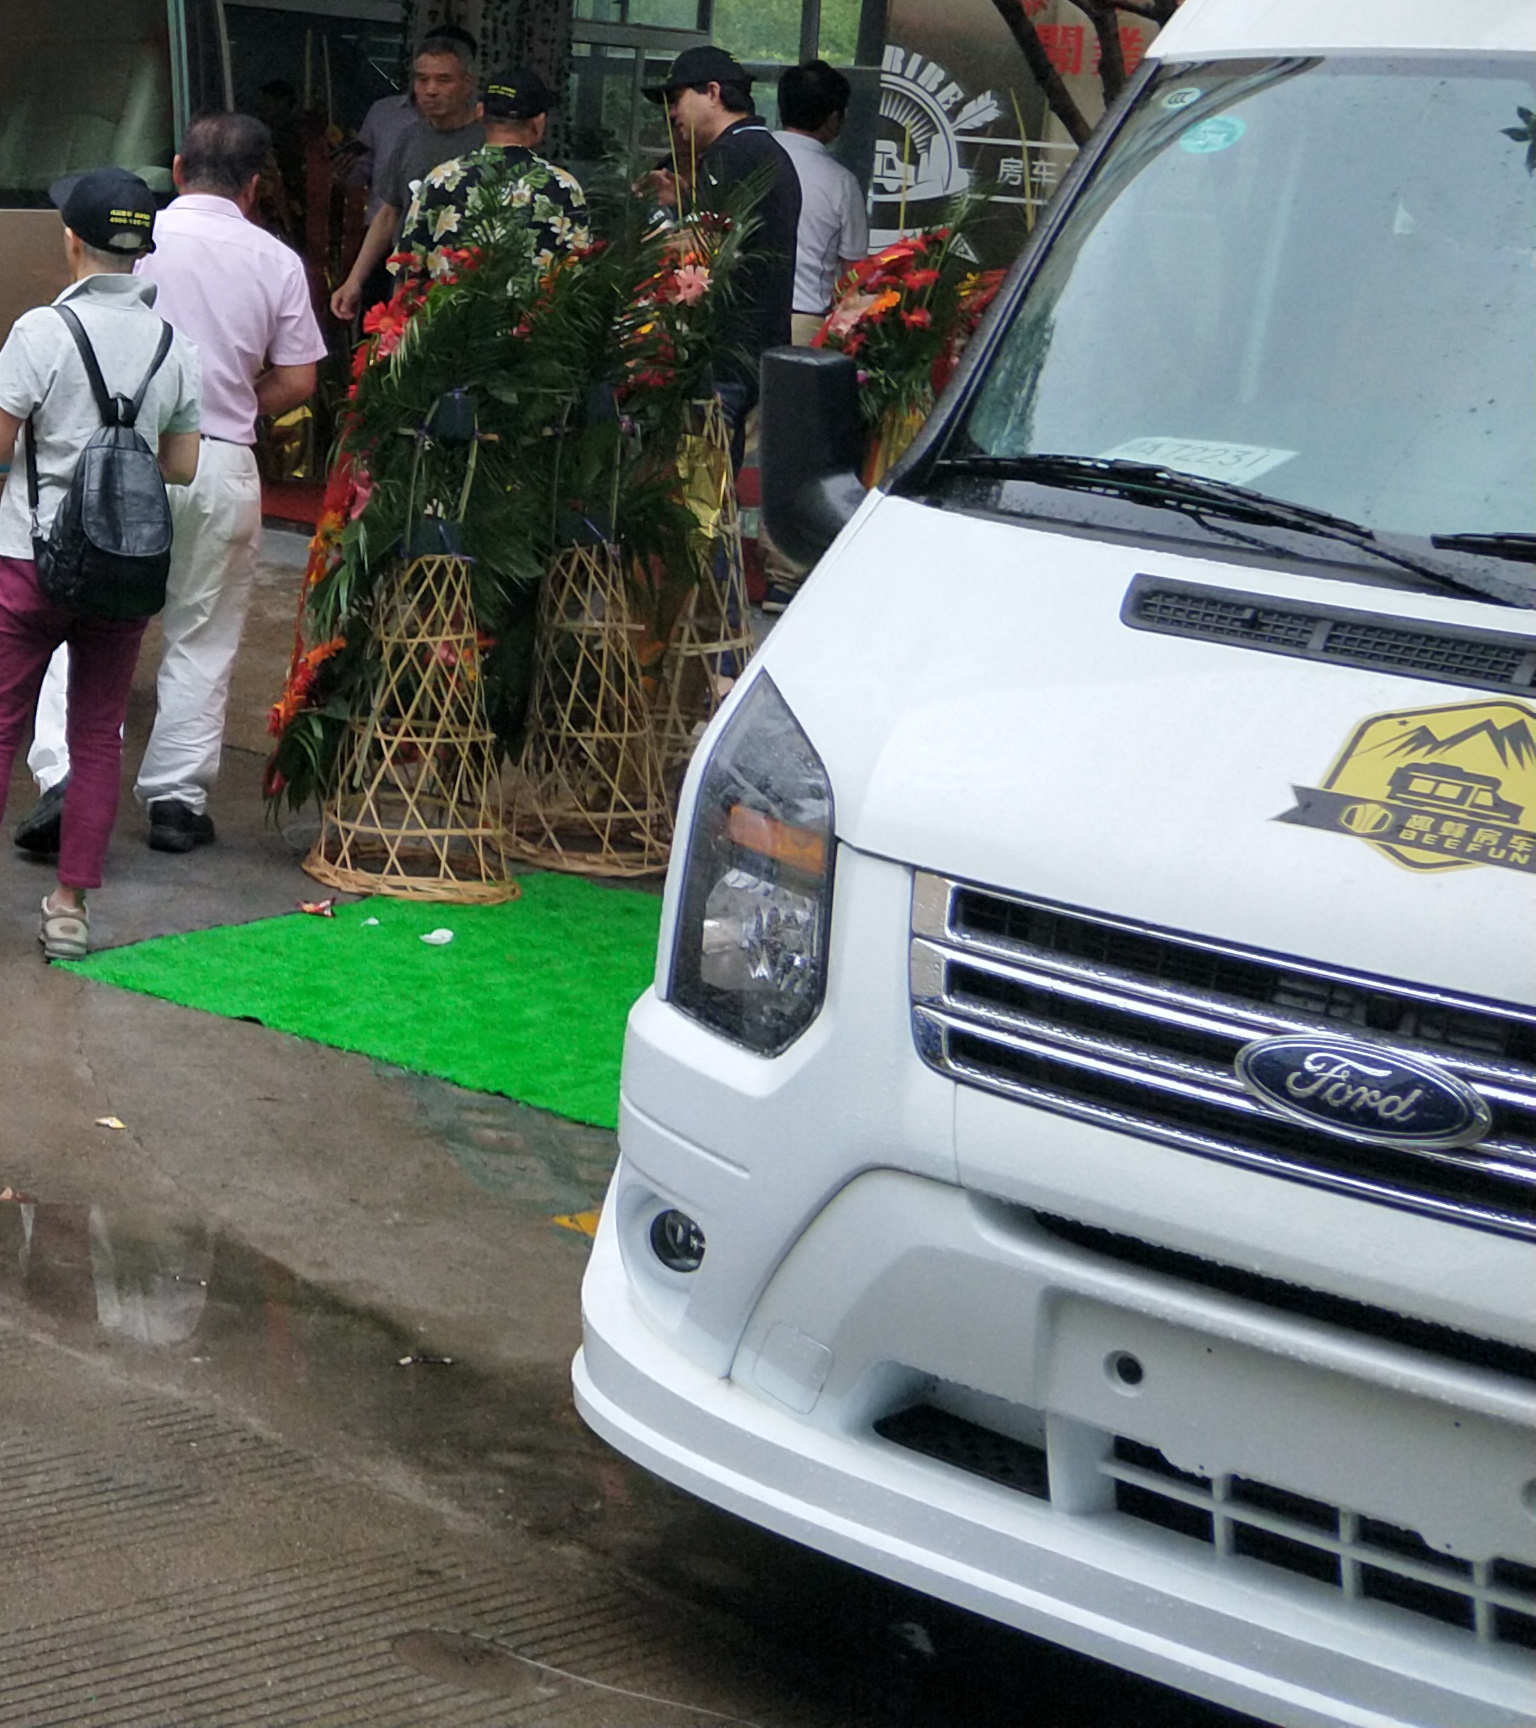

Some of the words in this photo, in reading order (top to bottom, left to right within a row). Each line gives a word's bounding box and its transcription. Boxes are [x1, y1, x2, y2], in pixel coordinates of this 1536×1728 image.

[880, 44, 965, 112] RIBE
[996, 157, 1072, 187] 房车
[1399, 828, 1530, 864] BEEFUN
[1286, 1052, 1422, 1122] Ford
